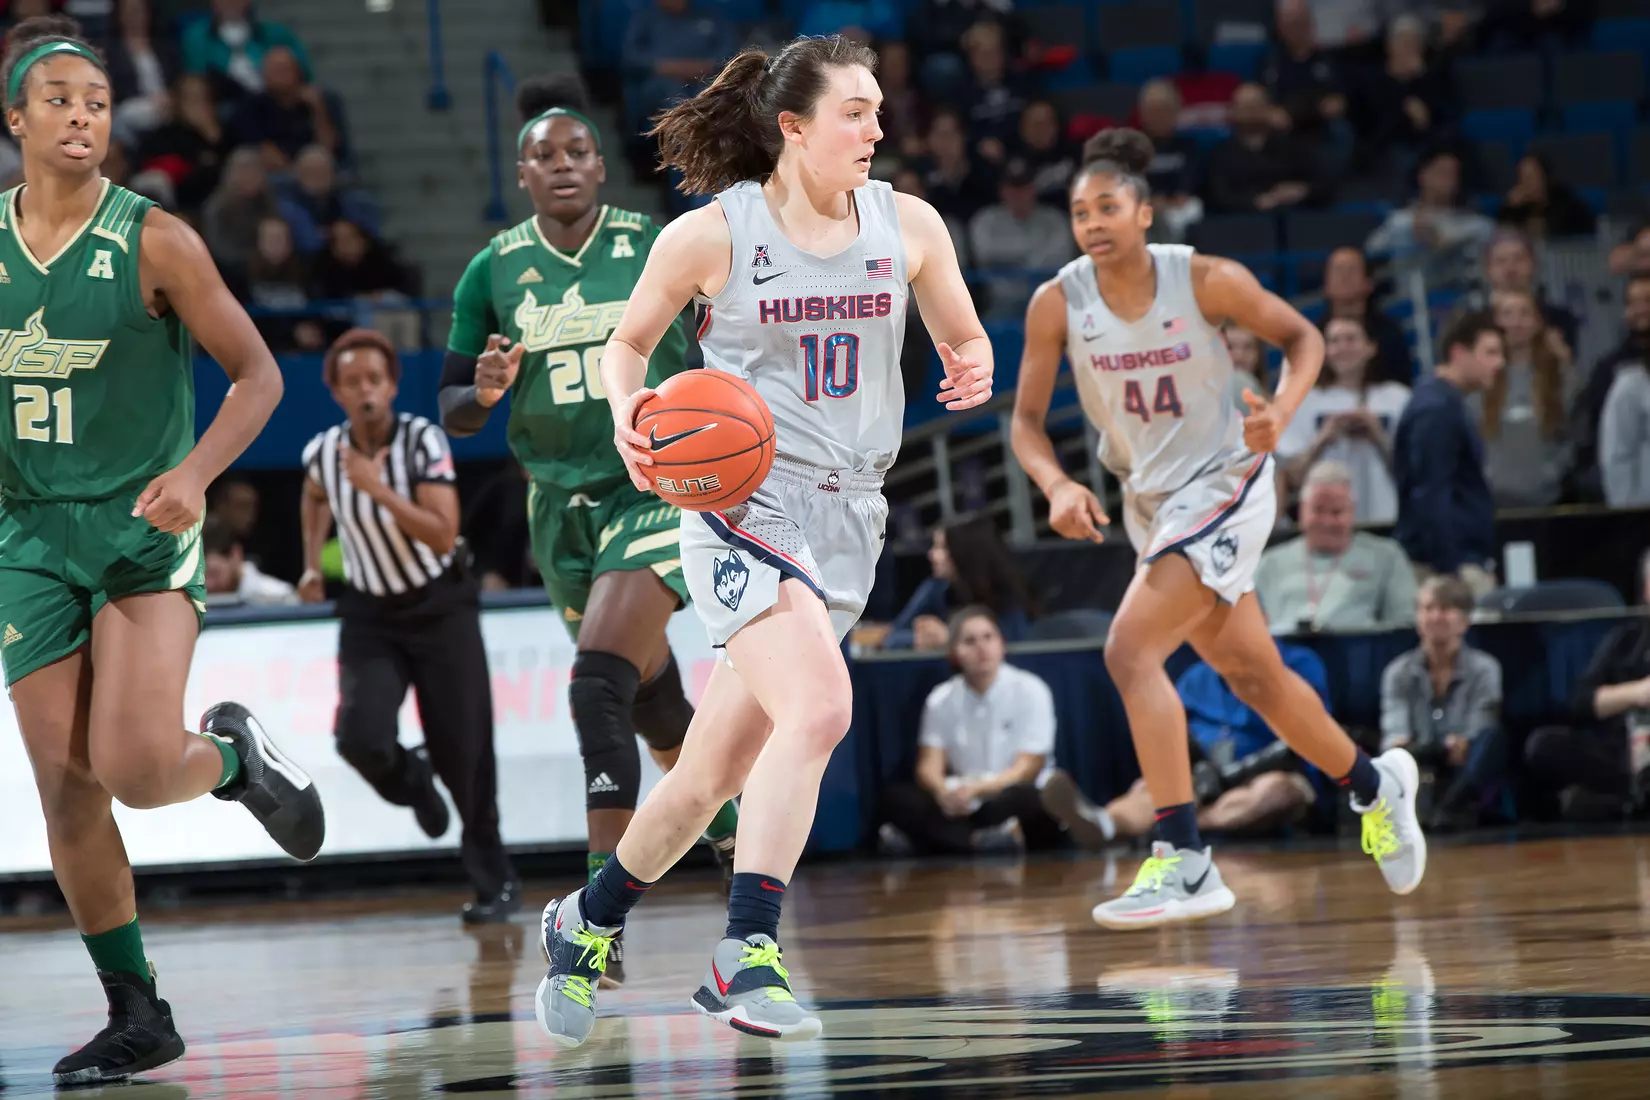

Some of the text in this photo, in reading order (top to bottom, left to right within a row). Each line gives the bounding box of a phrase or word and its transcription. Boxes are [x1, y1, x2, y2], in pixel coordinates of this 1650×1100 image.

[758, 292, 892, 324] HUSKIES
[799, 332, 860, 401] 10
[1090, 341, 1192, 372] HUSKIES
[13, 383, 74, 445] 21
[1124, 374, 1184, 423] 44
[656, 473, 721, 493] ELITE
[817, 482, 841, 493] UCONN
